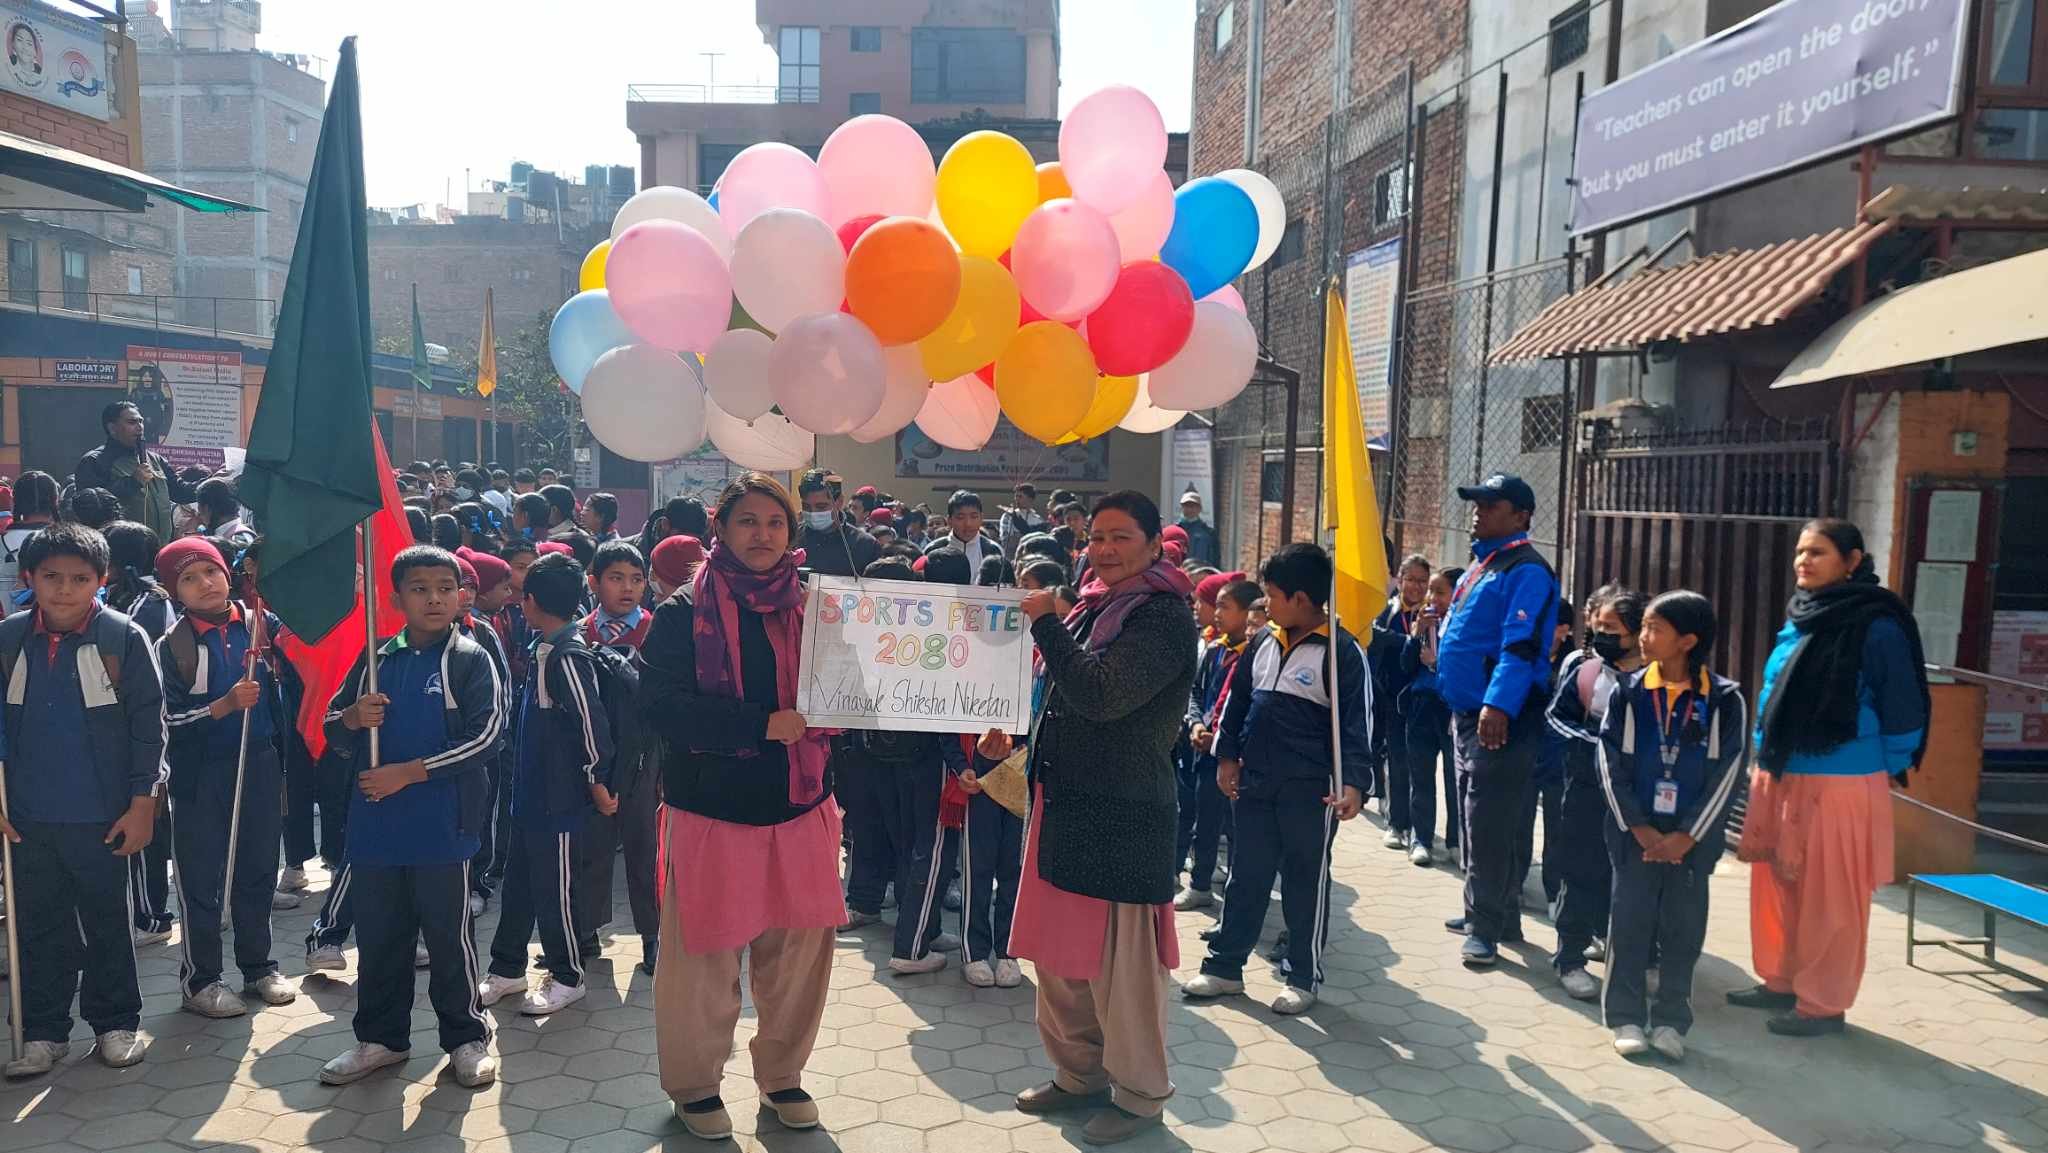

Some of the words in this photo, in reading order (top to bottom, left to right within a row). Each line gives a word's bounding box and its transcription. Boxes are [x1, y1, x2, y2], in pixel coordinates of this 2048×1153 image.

[1687, 76, 1725, 105] can
[1732, 47, 1792, 87] open
[1800, 23, 1842, 59] the
[1582, 169, 1610, 198] but
[1615, 160, 1649, 191] you
[1654, 135, 1704, 172] must
[1709, 113, 1769, 152] enter
[1776, 99, 1795, 129] it
[57, 363, 117, 373] LABORATORY
[819, 593, 934, 627] SPORTS
[947, 601, 1022, 632] FETE
[875, 632, 969, 670] 2080
[815, 674, 885, 717] Vinayak
[891, 678, 946, 714] Shiksha
[951, 680, 1010, 717] Niketan
